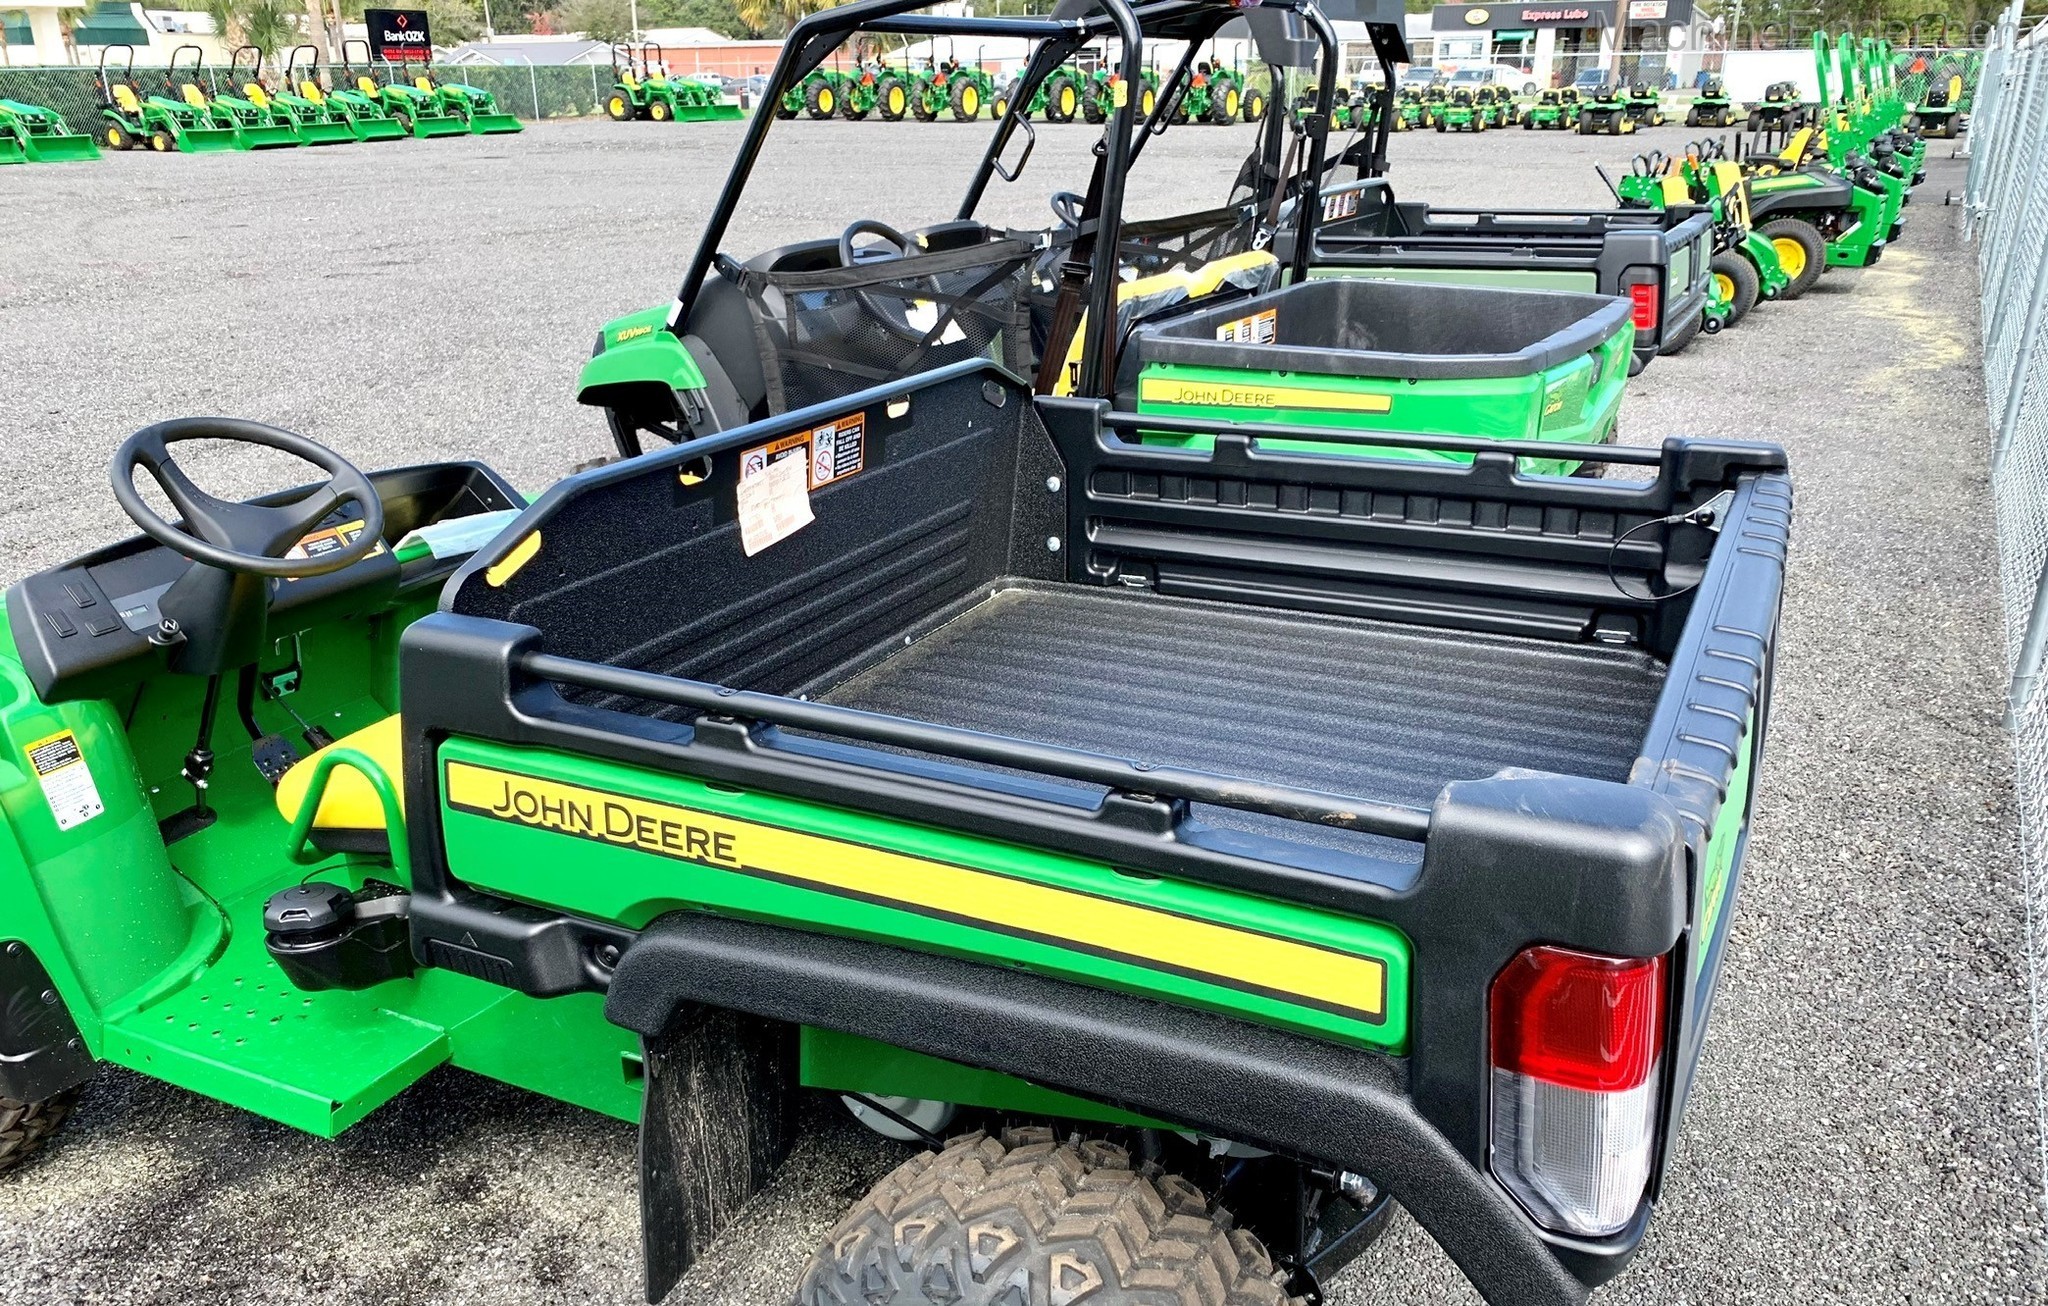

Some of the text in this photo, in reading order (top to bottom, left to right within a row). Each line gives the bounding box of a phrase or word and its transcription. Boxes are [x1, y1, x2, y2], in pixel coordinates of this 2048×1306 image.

[1522, 9, 1588, 21] Express Lube
[1174, 388, 1275, 405] JOHN DEERE
[780, 435, 804, 449] WARNING
[493, 781, 737, 862] JOHN DEERE
